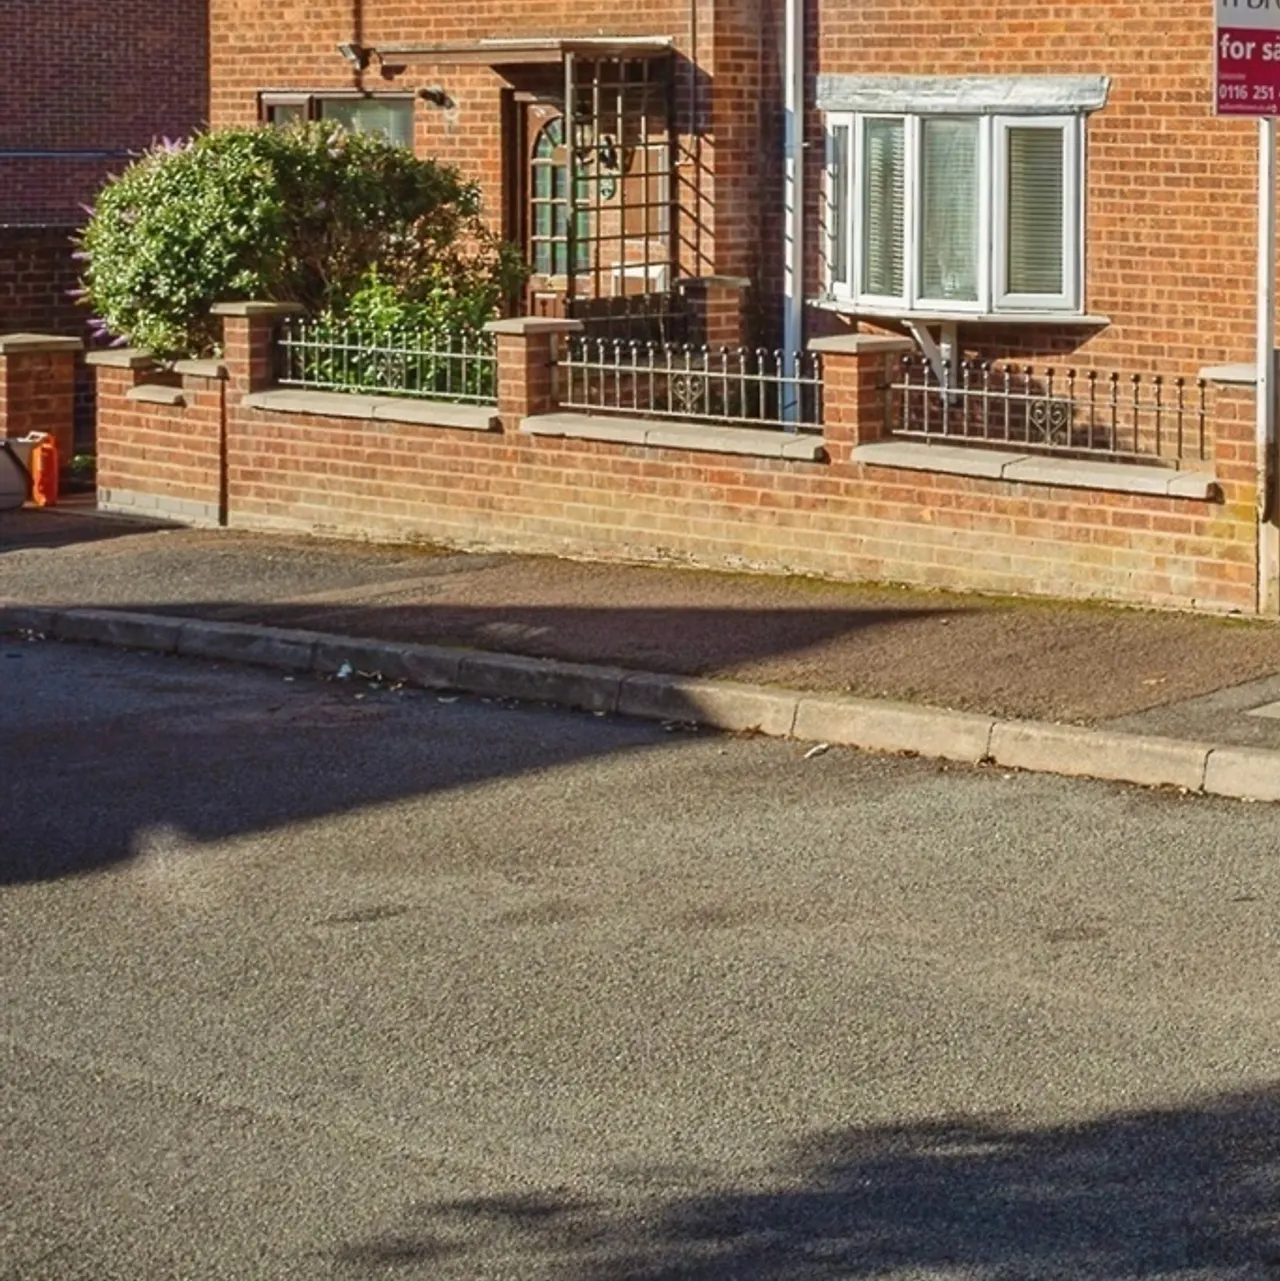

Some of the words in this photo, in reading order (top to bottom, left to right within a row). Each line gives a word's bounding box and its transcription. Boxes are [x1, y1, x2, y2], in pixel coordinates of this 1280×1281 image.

[1220, 33, 1256, 60] for
[1219, 84, 1248, 99] 0116
[1252, 85, 1275, 100] 251
